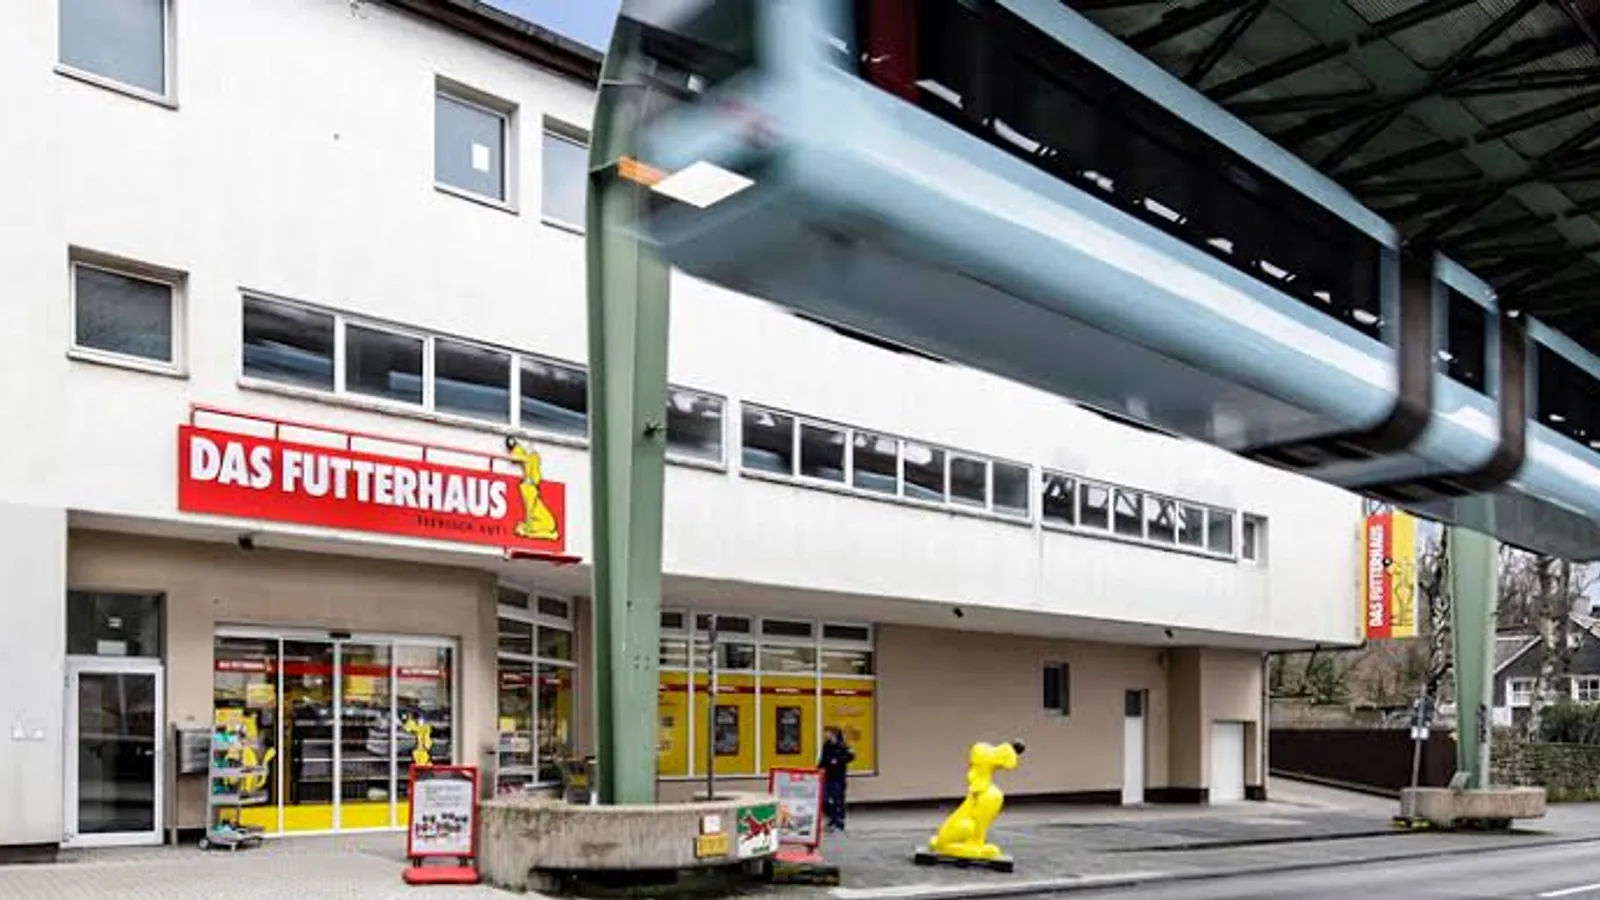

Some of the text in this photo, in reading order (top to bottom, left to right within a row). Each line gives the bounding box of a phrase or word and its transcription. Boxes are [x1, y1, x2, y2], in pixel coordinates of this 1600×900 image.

[190, 436, 507, 519] DAS FUTTERHAUS
[1369, 525, 1384, 627] DAS FUTTERHAUS
